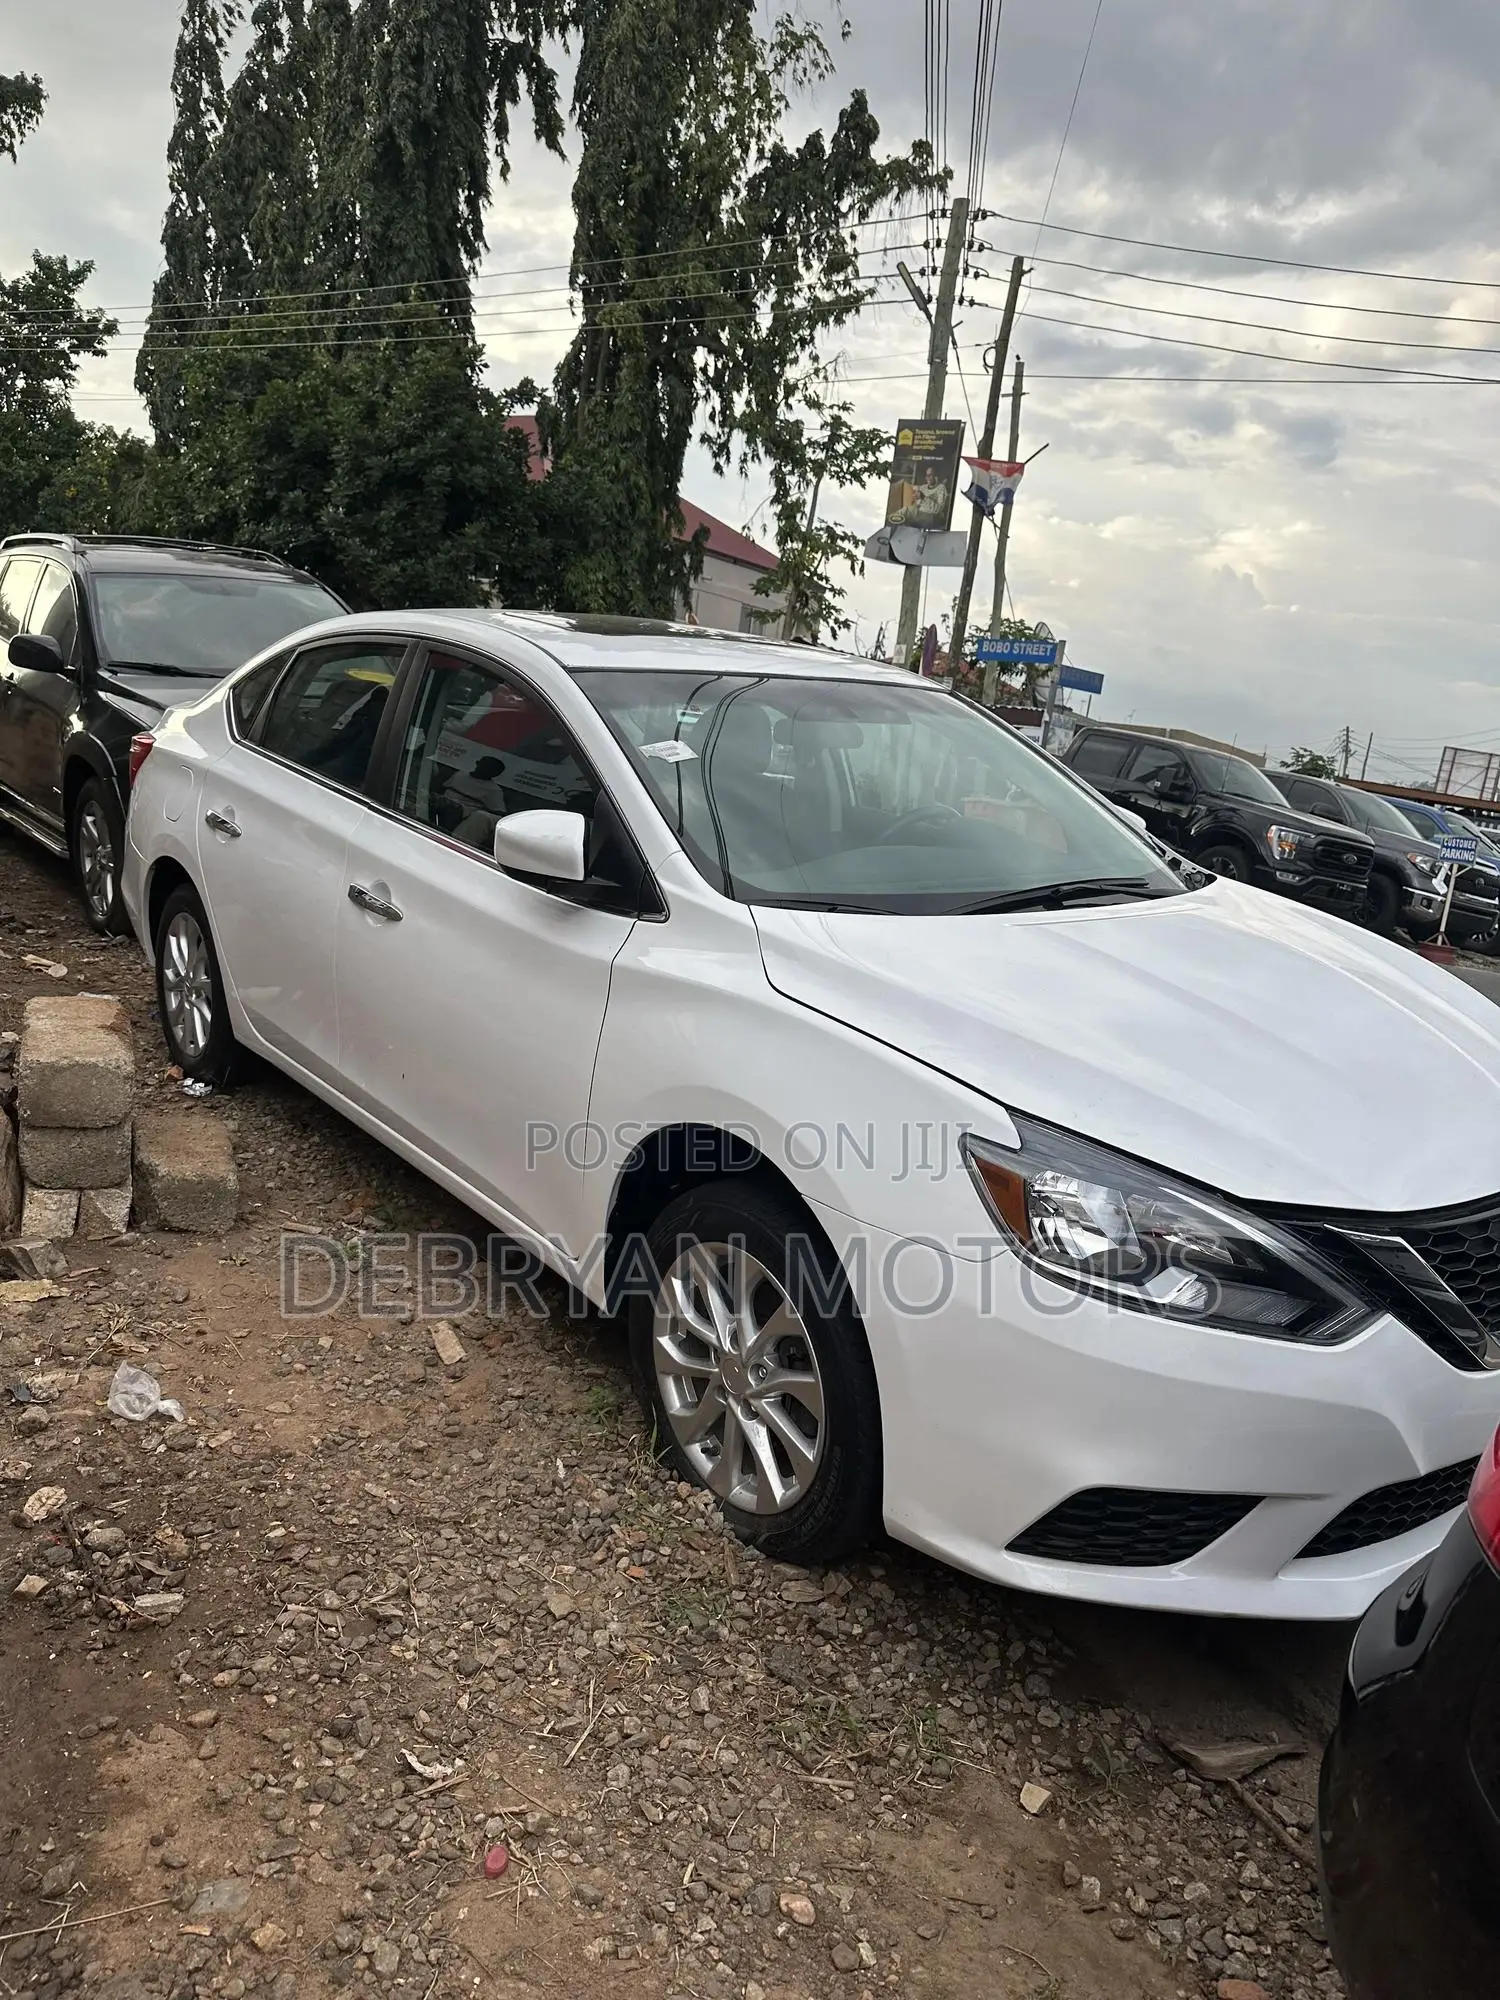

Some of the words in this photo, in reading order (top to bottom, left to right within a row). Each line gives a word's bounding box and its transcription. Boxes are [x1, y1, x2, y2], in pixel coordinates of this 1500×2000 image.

[982, 640, 1010, 655] BOBO
[1012, 642, 1053, 657] STREET
[1444, 838, 1476, 850] CUSTOMER
[1440, 848, 1474, 860] PARKING
